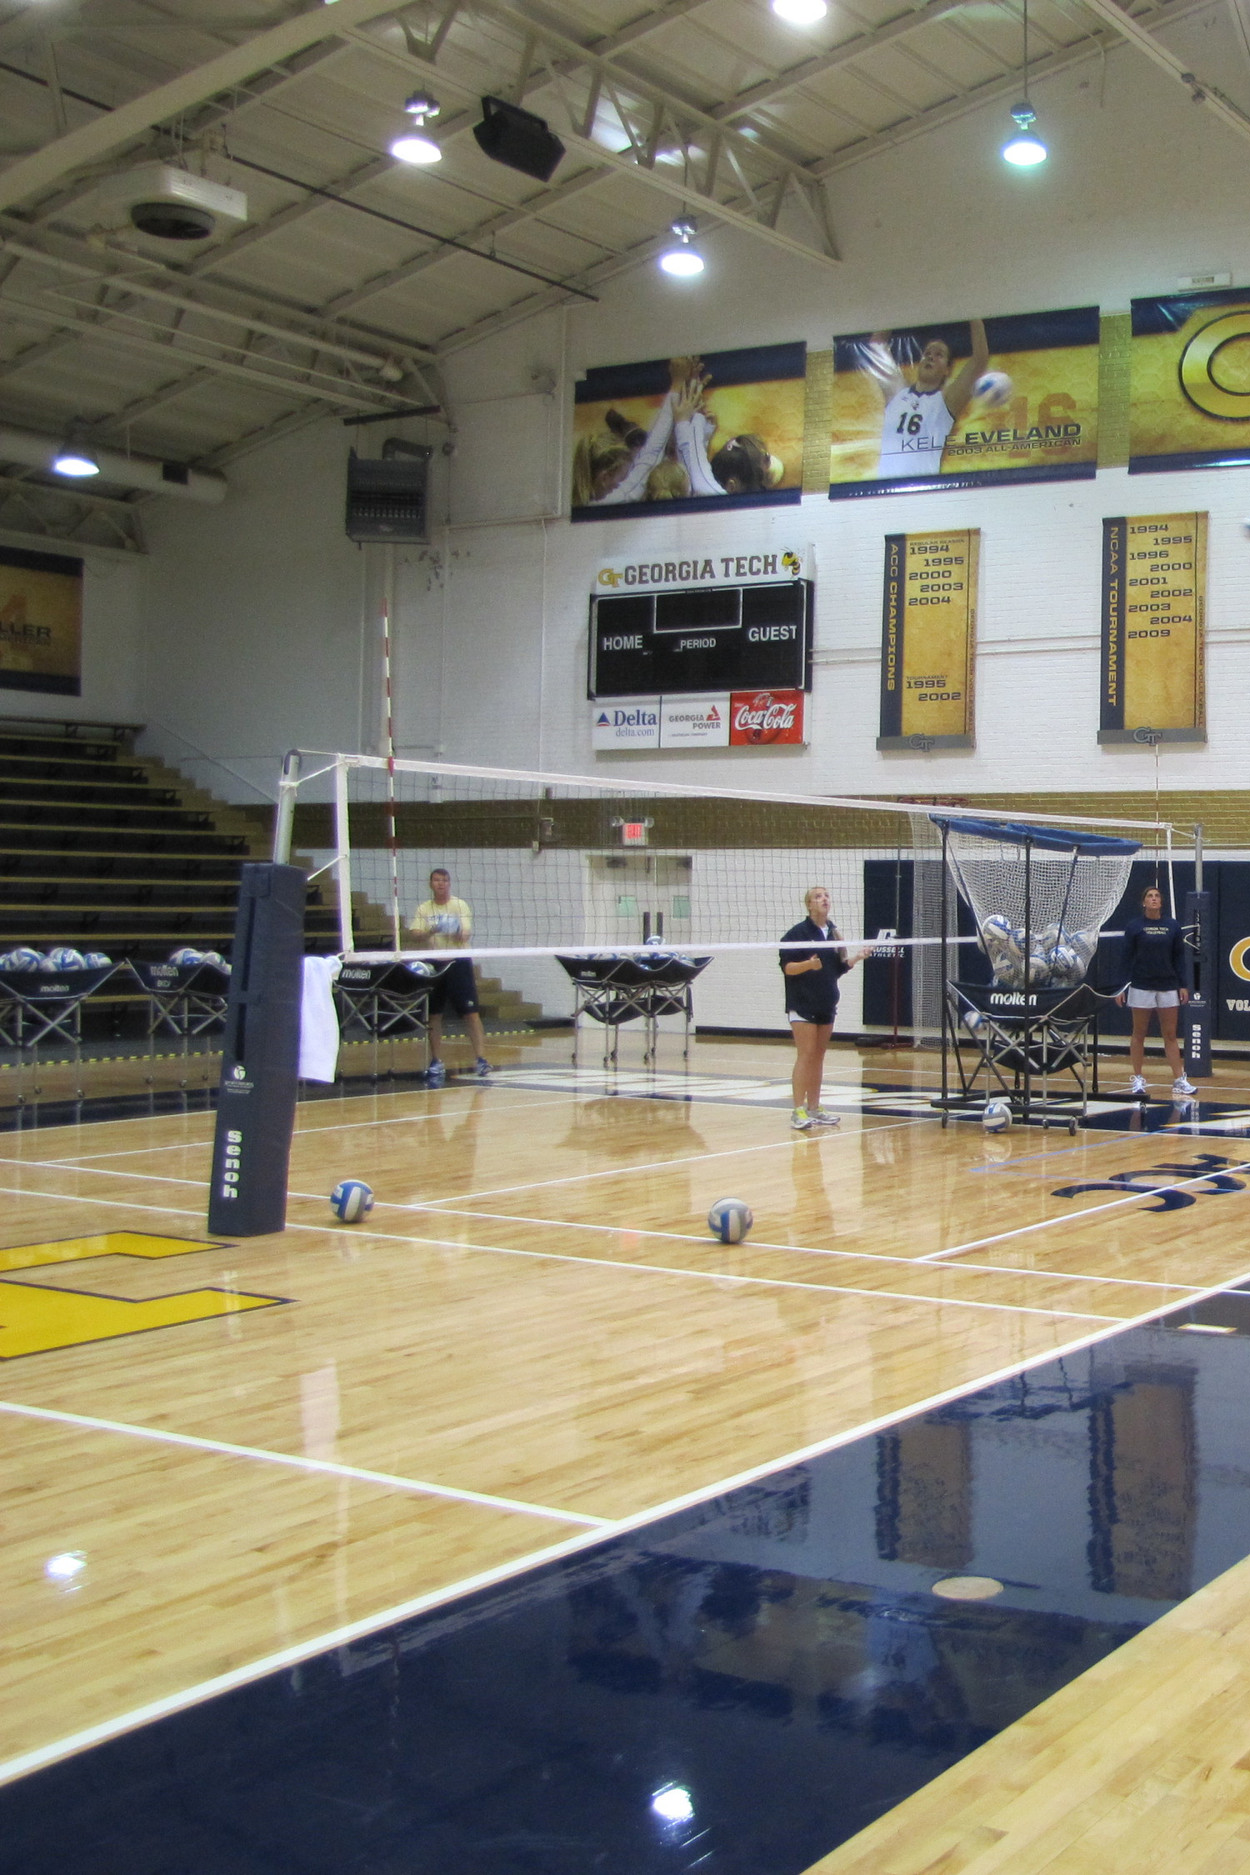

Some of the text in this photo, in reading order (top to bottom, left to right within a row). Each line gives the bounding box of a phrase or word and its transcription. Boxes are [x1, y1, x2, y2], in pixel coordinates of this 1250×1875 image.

[896, 411, 924, 436] 16
[901, 423, 1082, 452] KELE EVELAND
[947, 438, 1081, 457] 2003 ALL-AMERICAN
[1129, 524, 1169, 534] 1994
[1153, 535, 1193, 546] 1995
[909, 545, 950, 555] 1994
[1129, 550, 1169, 560] 1996
[924, 557, 964, 567] 1995
[1150, 561, 1193, 572] 2000
[597, 554, 778, 588] GT GEORGIA TECH
[908, 570, 952, 581] 2000
[1128, 576, 1168, 587] 2001
[920, 583, 964, 593] 2003
[1150, 588, 1193, 598] 2002
[908, 596, 951, 606] 2004
[1128, 603, 1171, 613] 2003
[887, 543, 900, 691] ACC CHAMPIONS
[1108, 526, 1119, 706] NCAA TOURNAMENT
[1150, 615, 1193, 625] 2004
[748, 625, 798, 641] GUEST
[1128, 629, 1171, 639] 2009
[603, 635, 643, 651] HOME
[680, 638, 716, 650] PERIOD
[906, 679, 947, 689] 1995
[918, 692, 962, 702] 2002
[613, 709, 657, 727] Delta
[669, 714, 705, 722] GEORGIA
[615, 726, 655, 737] delta.com
[692, 722, 721, 730] POWER
[1133, 727, 1162, 746] GT
[909, 734, 935, 752] GT
[221, 1129, 243, 1199] senoh
